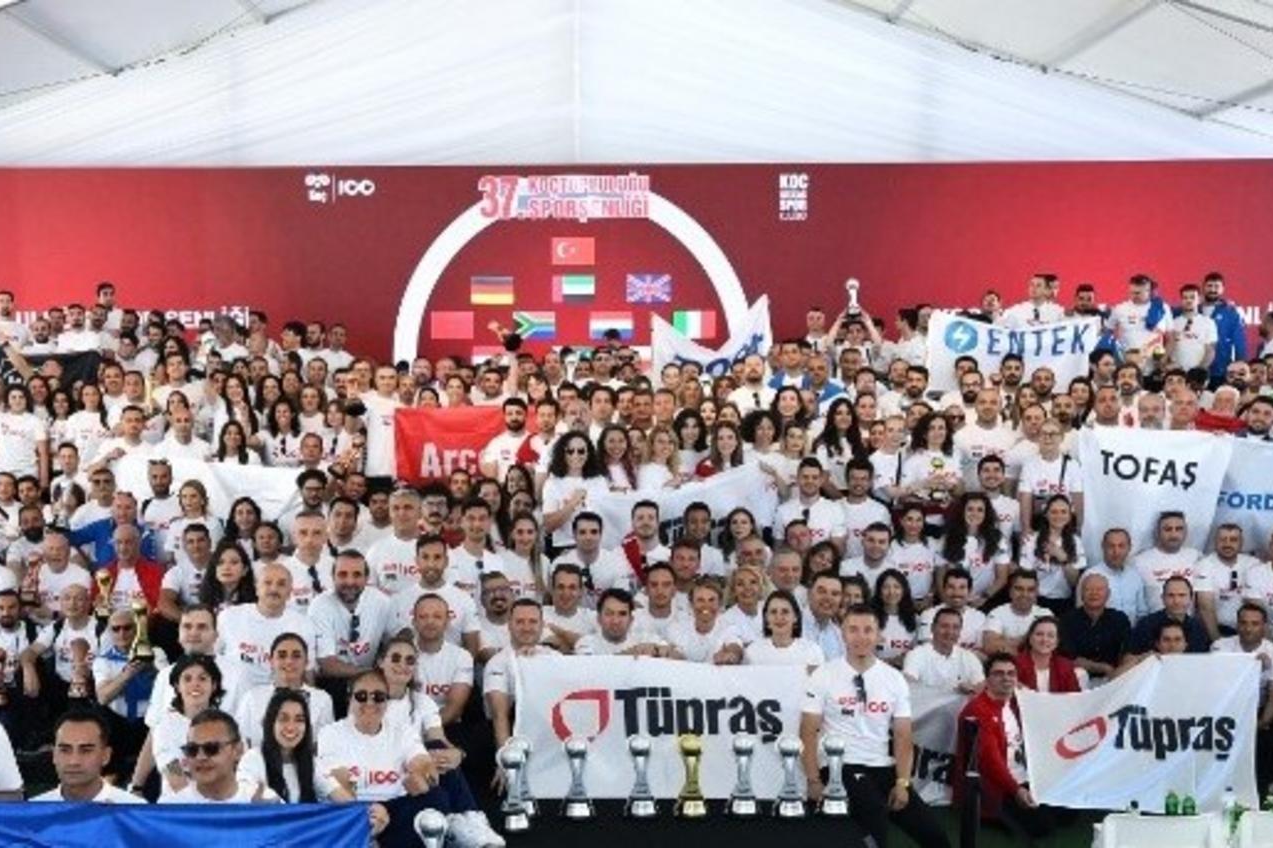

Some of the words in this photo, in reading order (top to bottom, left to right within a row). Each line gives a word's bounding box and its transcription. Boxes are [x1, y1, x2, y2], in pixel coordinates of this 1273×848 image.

[987, 323, 1089, 356] ENTEK
[1100, 449, 1198, 490] TOFAŞ
[1108, 704, 1236, 760] Tüpraş
[368, 770, 398, 784] 100
